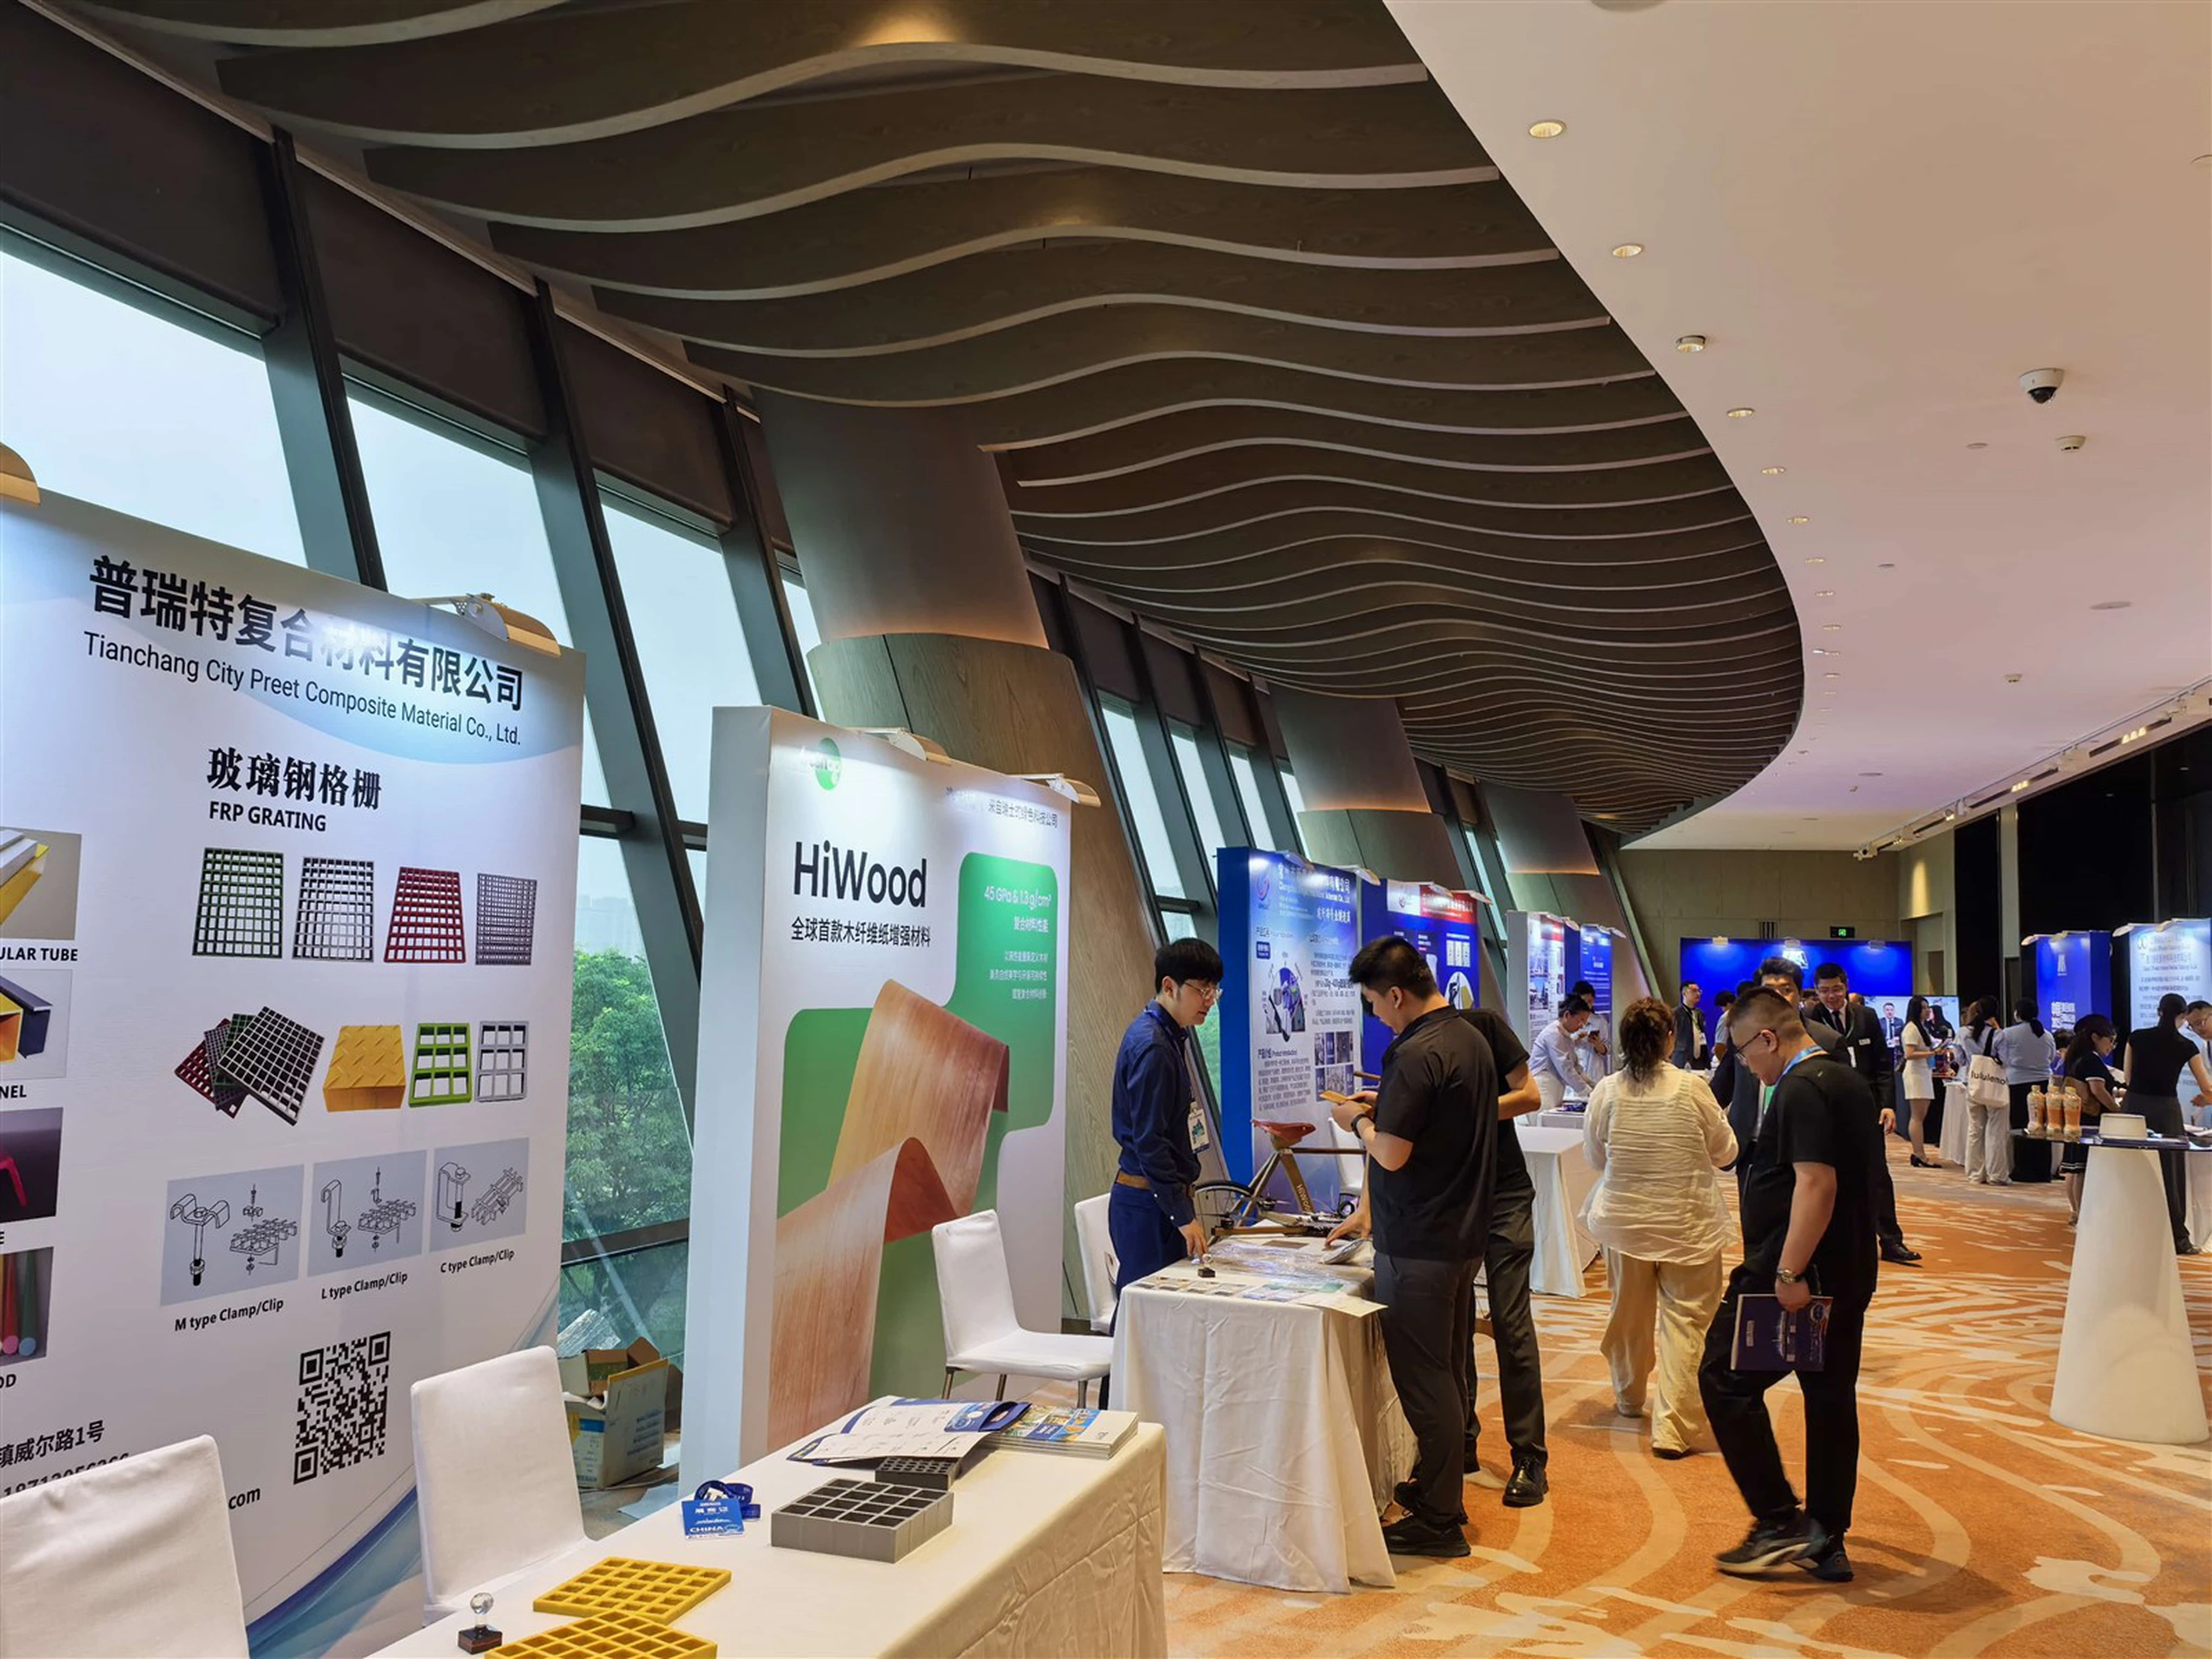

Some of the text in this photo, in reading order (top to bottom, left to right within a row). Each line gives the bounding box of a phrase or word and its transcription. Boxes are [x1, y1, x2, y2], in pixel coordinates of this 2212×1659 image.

[90, 555, 523, 711] 普瑞特复合材料有限公司
[84, 631, 521, 745] Tianchang City Preet Composite Material Co., Ltd.
[207, 747, 381, 810] 玻璃钢格栅
[210, 801, 326, 832] FRP GRATING
[794, 840, 927, 907] HiWood
[984, 886, 995, 901] 45
[791, 916, 930, 947] 全球首款木纤维纸增强材料
[40, 948, 78, 961] TUBE
[441, 1249, 515, 1274] C type Clamp/Clip
[322, 1272, 408, 1300] L type Clamp/Clip
[175, 1298, 284, 1331] M type Clamp/Clip
[228, 1488, 260, 1509] com
